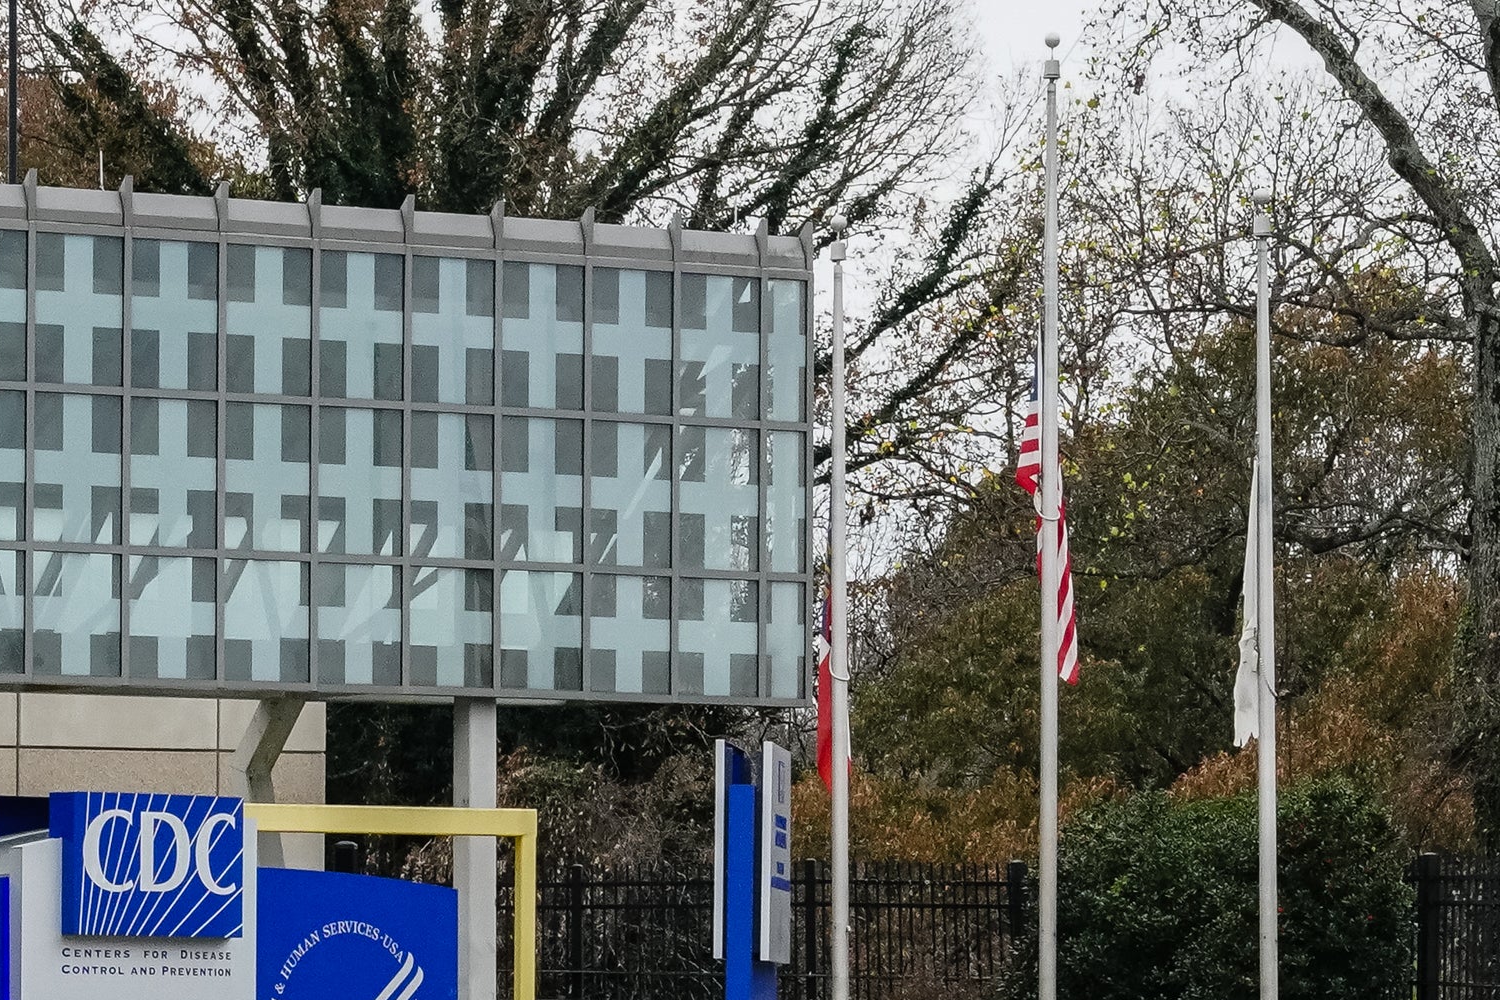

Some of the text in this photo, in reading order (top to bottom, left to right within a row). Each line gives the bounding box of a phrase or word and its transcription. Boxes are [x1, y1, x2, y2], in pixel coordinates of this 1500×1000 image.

[83, 809, 236, 895] CDC
[143, 950, 168, 959] FOR
[280, 930, 321, 981] HUMAN
[131, 966, 156, 975] AND
